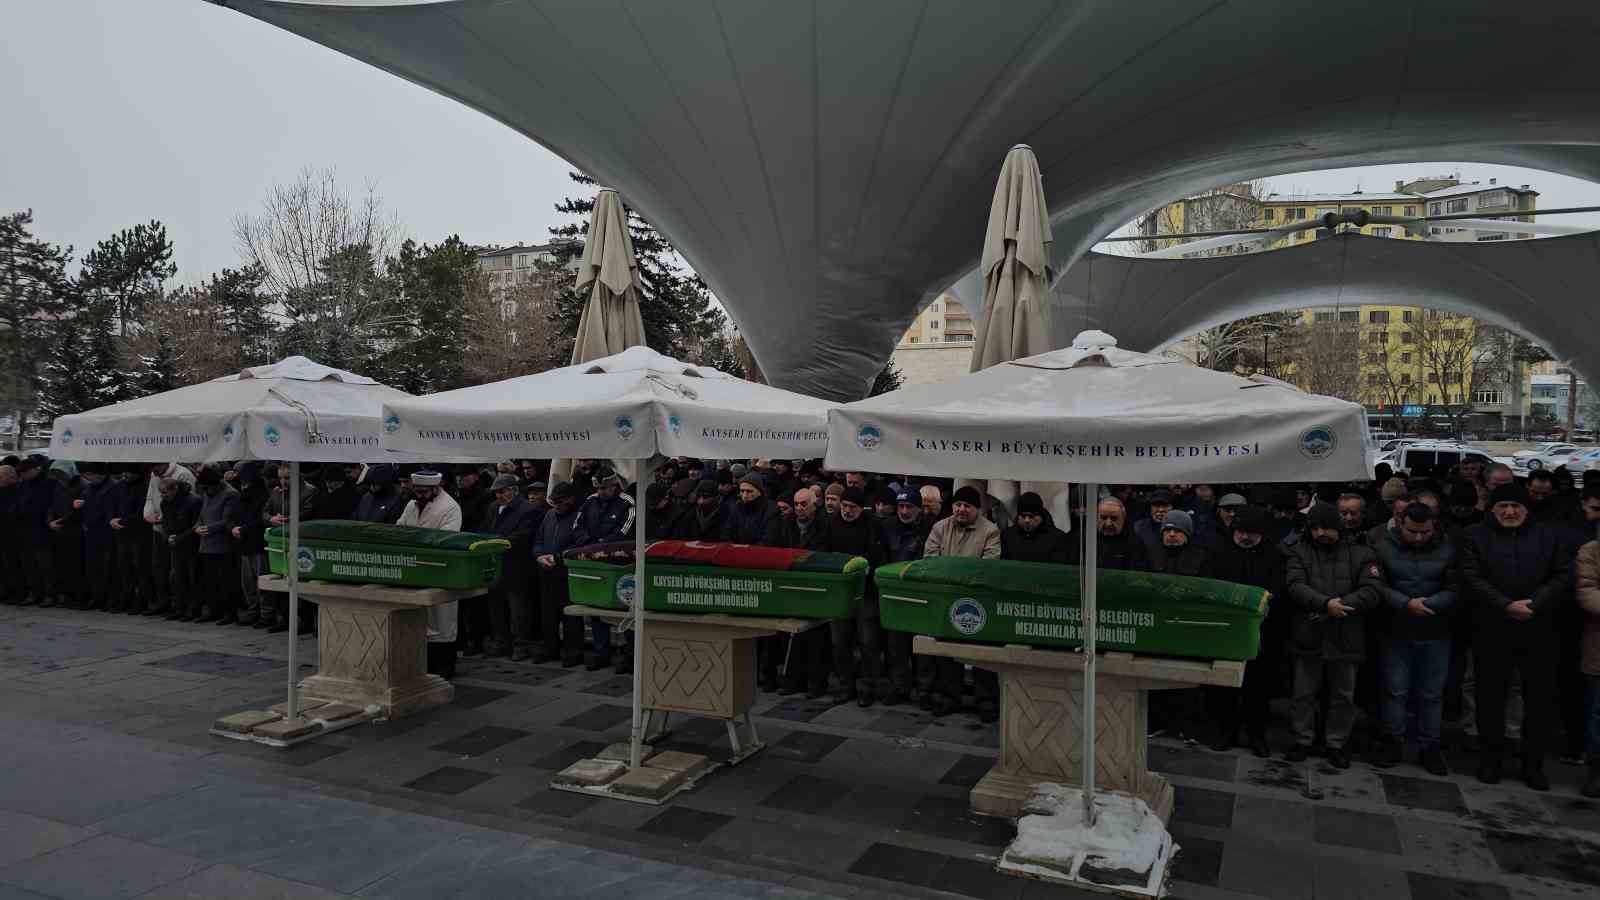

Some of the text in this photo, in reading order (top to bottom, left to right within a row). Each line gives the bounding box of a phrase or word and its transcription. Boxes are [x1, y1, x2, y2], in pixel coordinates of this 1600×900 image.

[915, 438, 1259, 458] KAYSERİ BÜYÜKŞEHİR BELEDİYESİ
[996, 601, 1034, 618] KAYSERİ
[1099, 609, 1155, 627] BELEDİYESİ
[1015, 621, 1076, 640] MEZARLIKLAR
